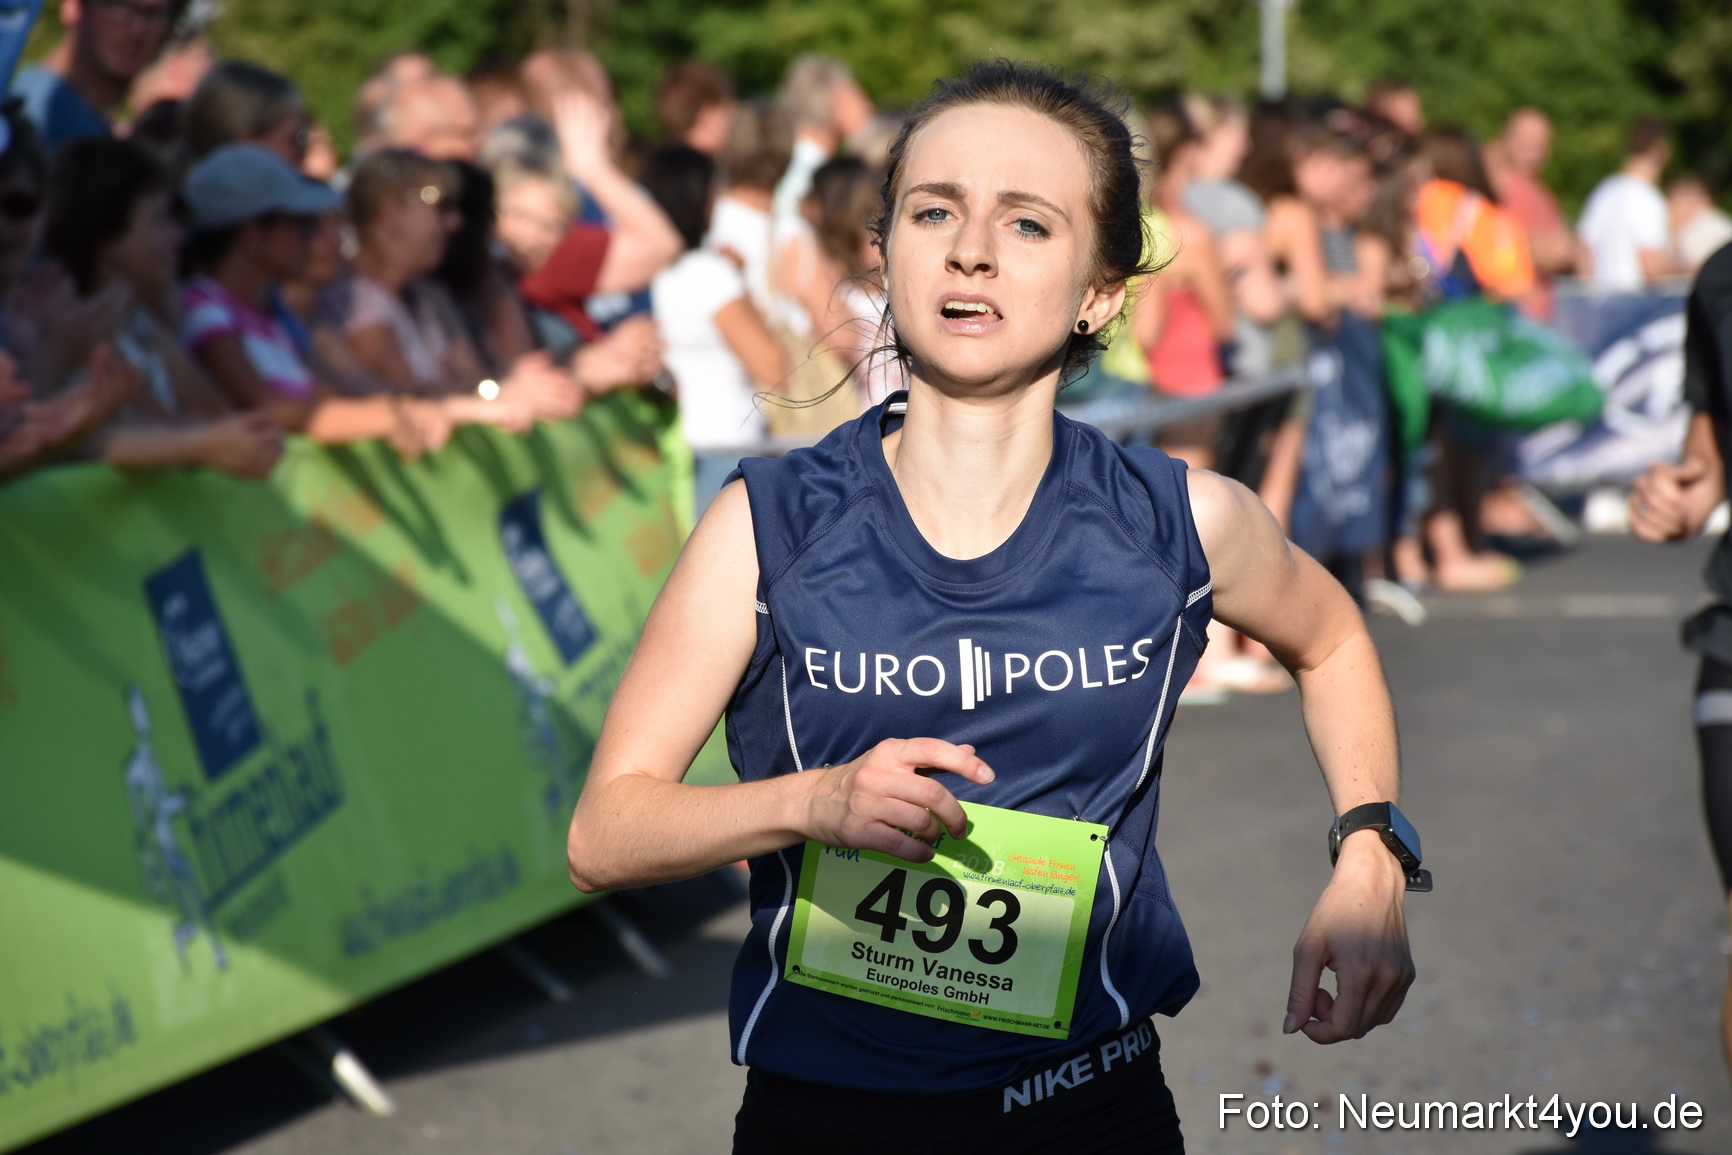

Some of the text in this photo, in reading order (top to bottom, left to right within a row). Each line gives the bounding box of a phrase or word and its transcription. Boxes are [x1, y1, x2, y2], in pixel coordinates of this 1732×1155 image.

[805, 638, 1153, 697] EURO POLES
[952, 853, 1005, 876] 2018
[1007, 853, 1076, 871] Gesunde Firmen
[1022, 866, 1048, 878] laufen
[962, 871, 1077, 896] www.firmenlauf-oberpfalz.de
[854, 867, 1021, 966] 493
[851, 941, 1014, 992] Sturm Vanessa
[859, 986, 880, 997] gedruckt
[866, 967, 990, 1006] Europoles GmbH
[937, 1005, 971, 1019] Frischmann
[1003, 1052, 1094, 1114] NIKE
